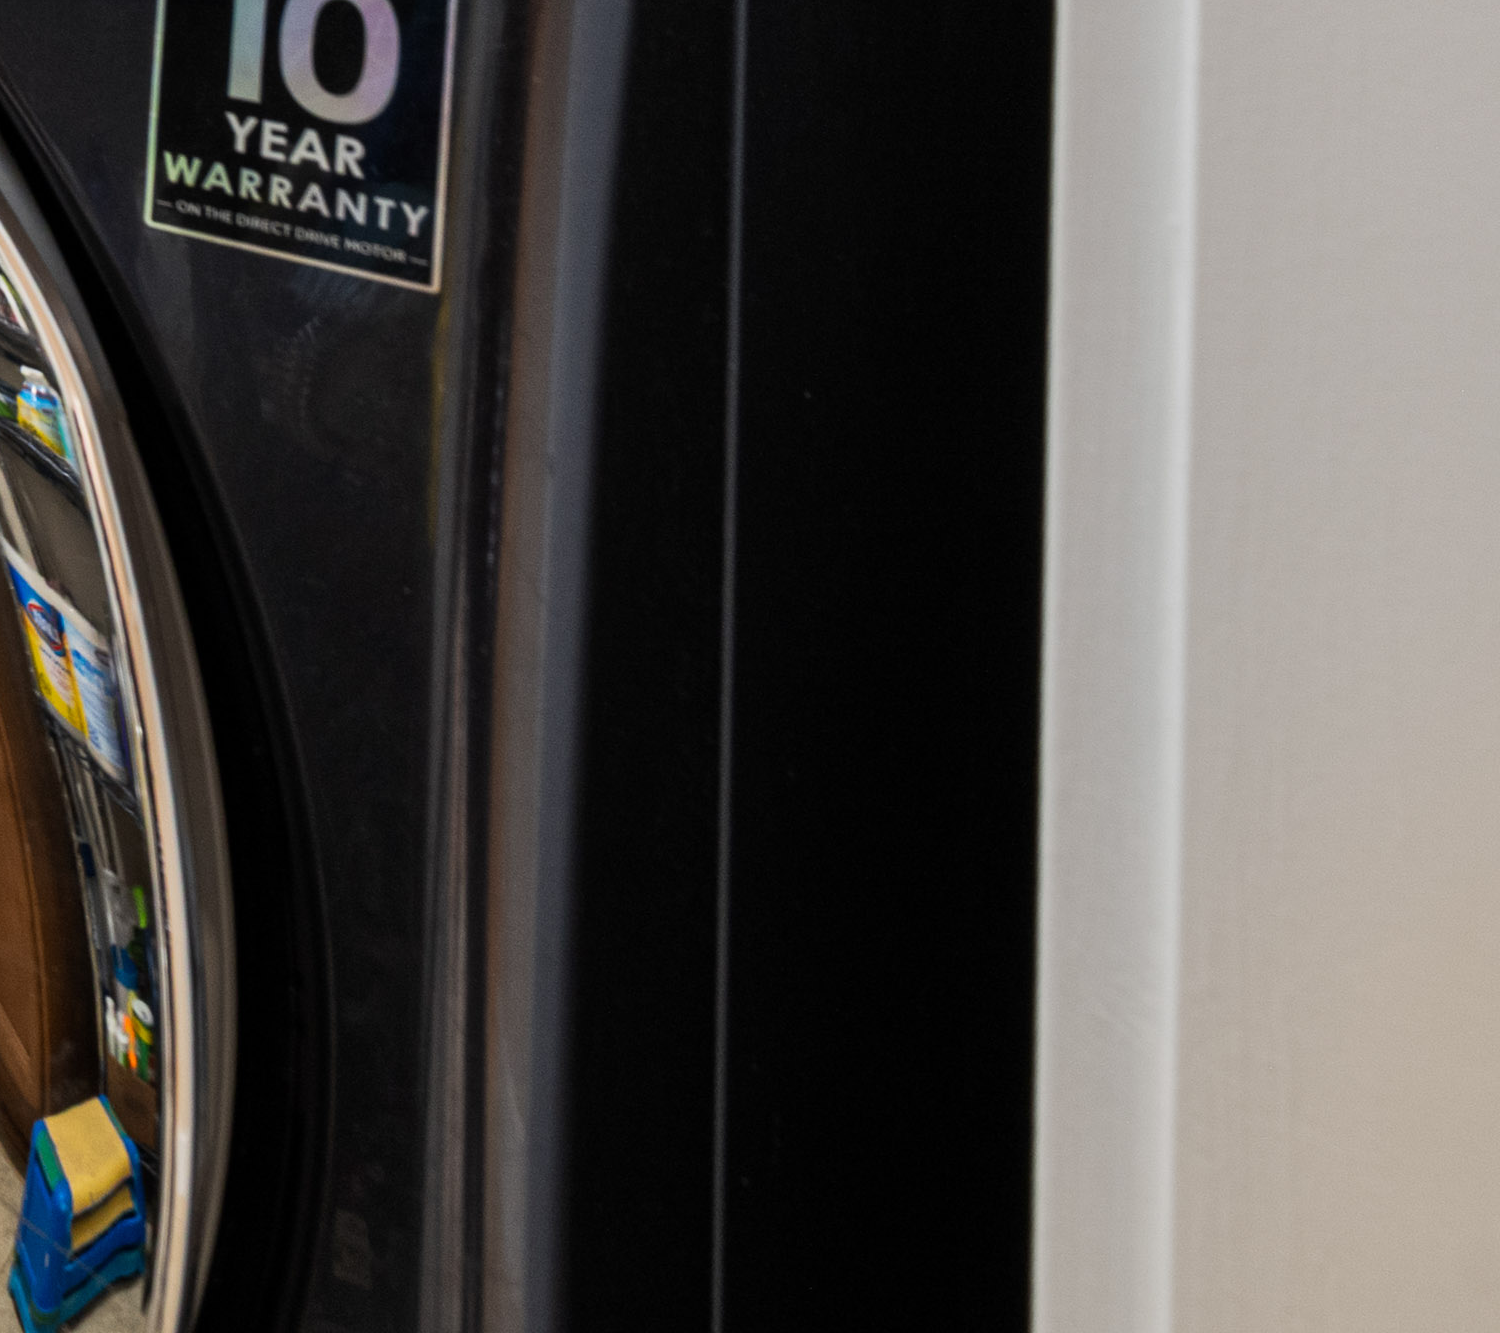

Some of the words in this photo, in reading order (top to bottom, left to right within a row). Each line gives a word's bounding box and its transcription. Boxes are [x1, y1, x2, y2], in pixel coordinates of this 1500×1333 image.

[224, 111, 366, 181] YEAR
[163, 149, 429, 238] WARRANTY
[175, 199, 201, 217] ON
[204, 205, 232, 226] THE
[235, 212, 291, 237] DIRECT
[294, 226, 341, 249] DRIVE
[343, 238, 407, 264] MOTOR
